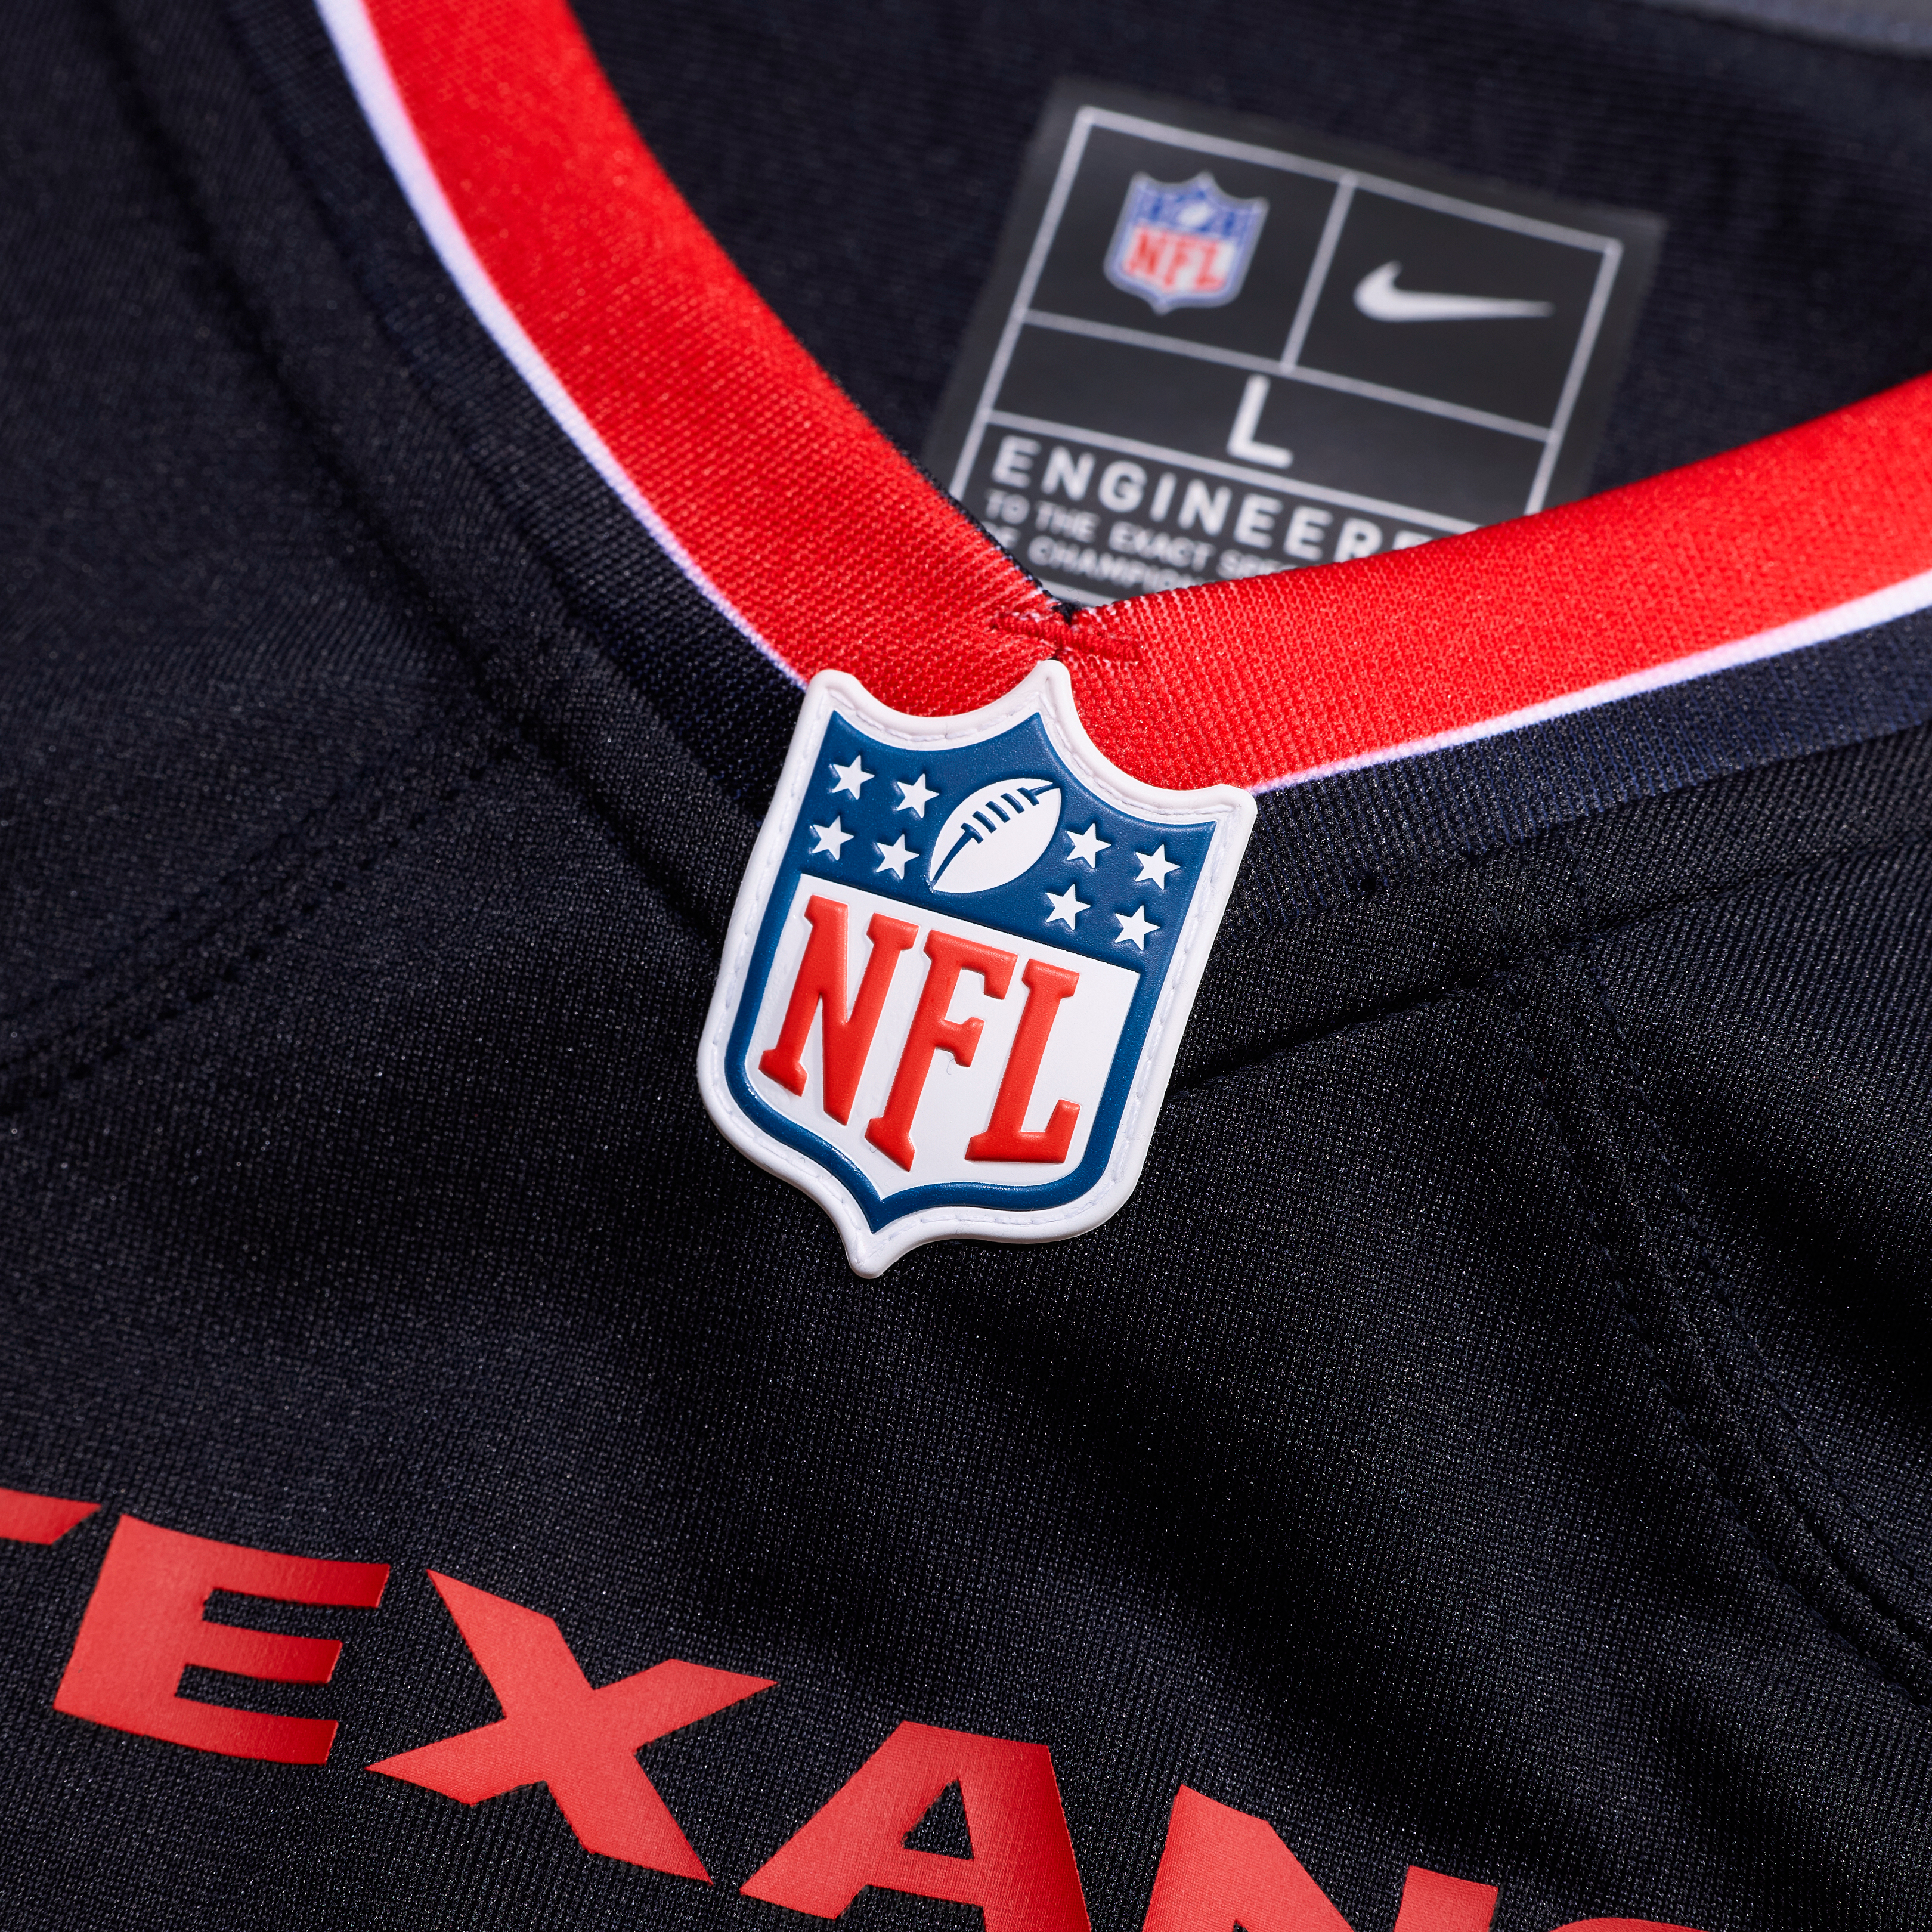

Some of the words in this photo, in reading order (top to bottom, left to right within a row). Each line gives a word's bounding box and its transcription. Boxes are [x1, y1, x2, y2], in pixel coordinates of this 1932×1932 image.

[1123, 227, 1226, 292] NFL
[1228, 376, 1293, 467] L
[985, 488, 1030, 525] TO
[1034, 500, 1101, 544] THE
[1108, 520, 1217, 572] EXACT
[758, 893, 1082, 1172] NFL
